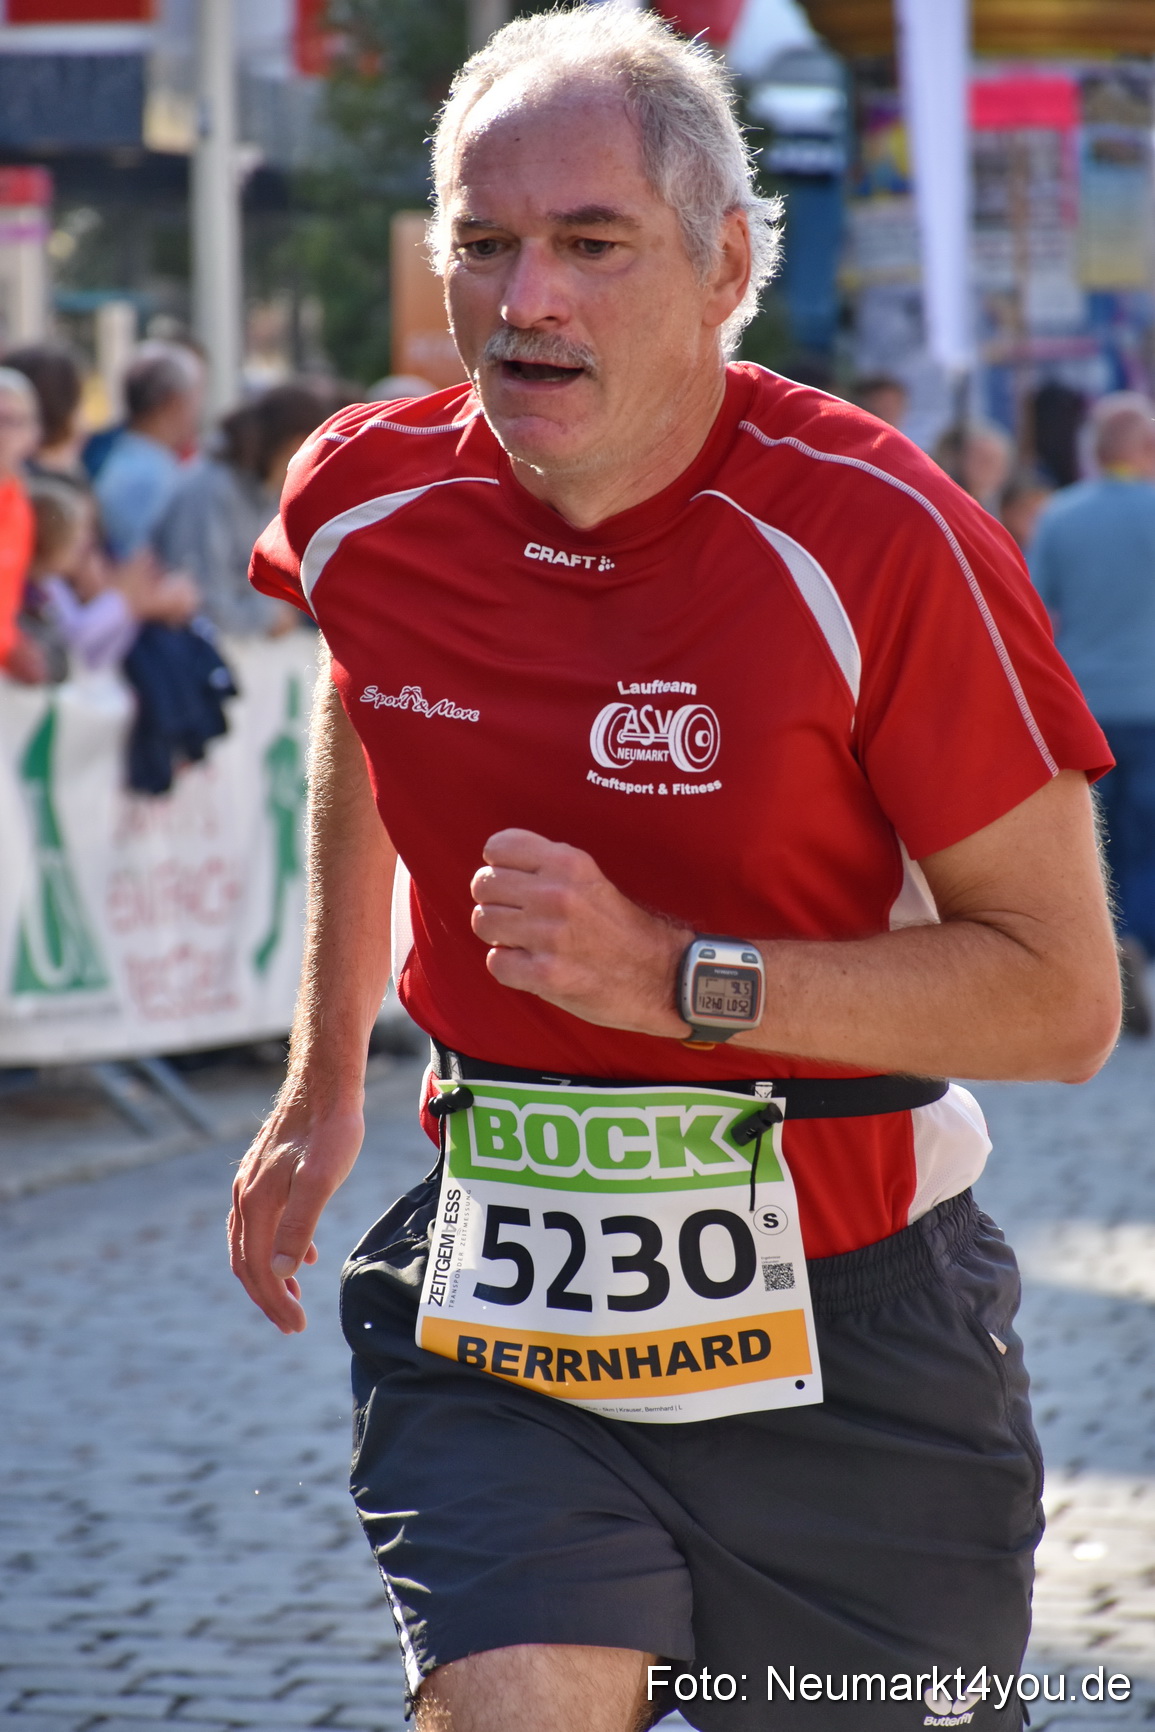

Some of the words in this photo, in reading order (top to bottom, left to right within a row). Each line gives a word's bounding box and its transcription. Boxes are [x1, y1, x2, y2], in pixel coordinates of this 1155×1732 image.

[523, 542, 597, 569] CRAFT
[360, 685, 409, 710] Sport
[412, 699, 428, 713] &
[425, 698, 480, 722] More
[617, 679, 697, 695] Laufteam
[622, 704, 674, 746] ASV
[616, 747, 669, 762] NEUMARKT
[586, 769, 654, 795] Kraftsport
[657, 783, 668, 795] &
[672, 779, 722, 796] Fitness
[472, 1099, 738, 1178] BOCK
[448, 1251, 464, 1308] TRANSPONDER
[460, 1189, 472, 1247] ZEITMESSUNG
[473, 1204, 757, 1313] 5230
[456, 1328, 772, 1383] BERRNHARD
[923, 1711, 975, 1727] Butterfly
